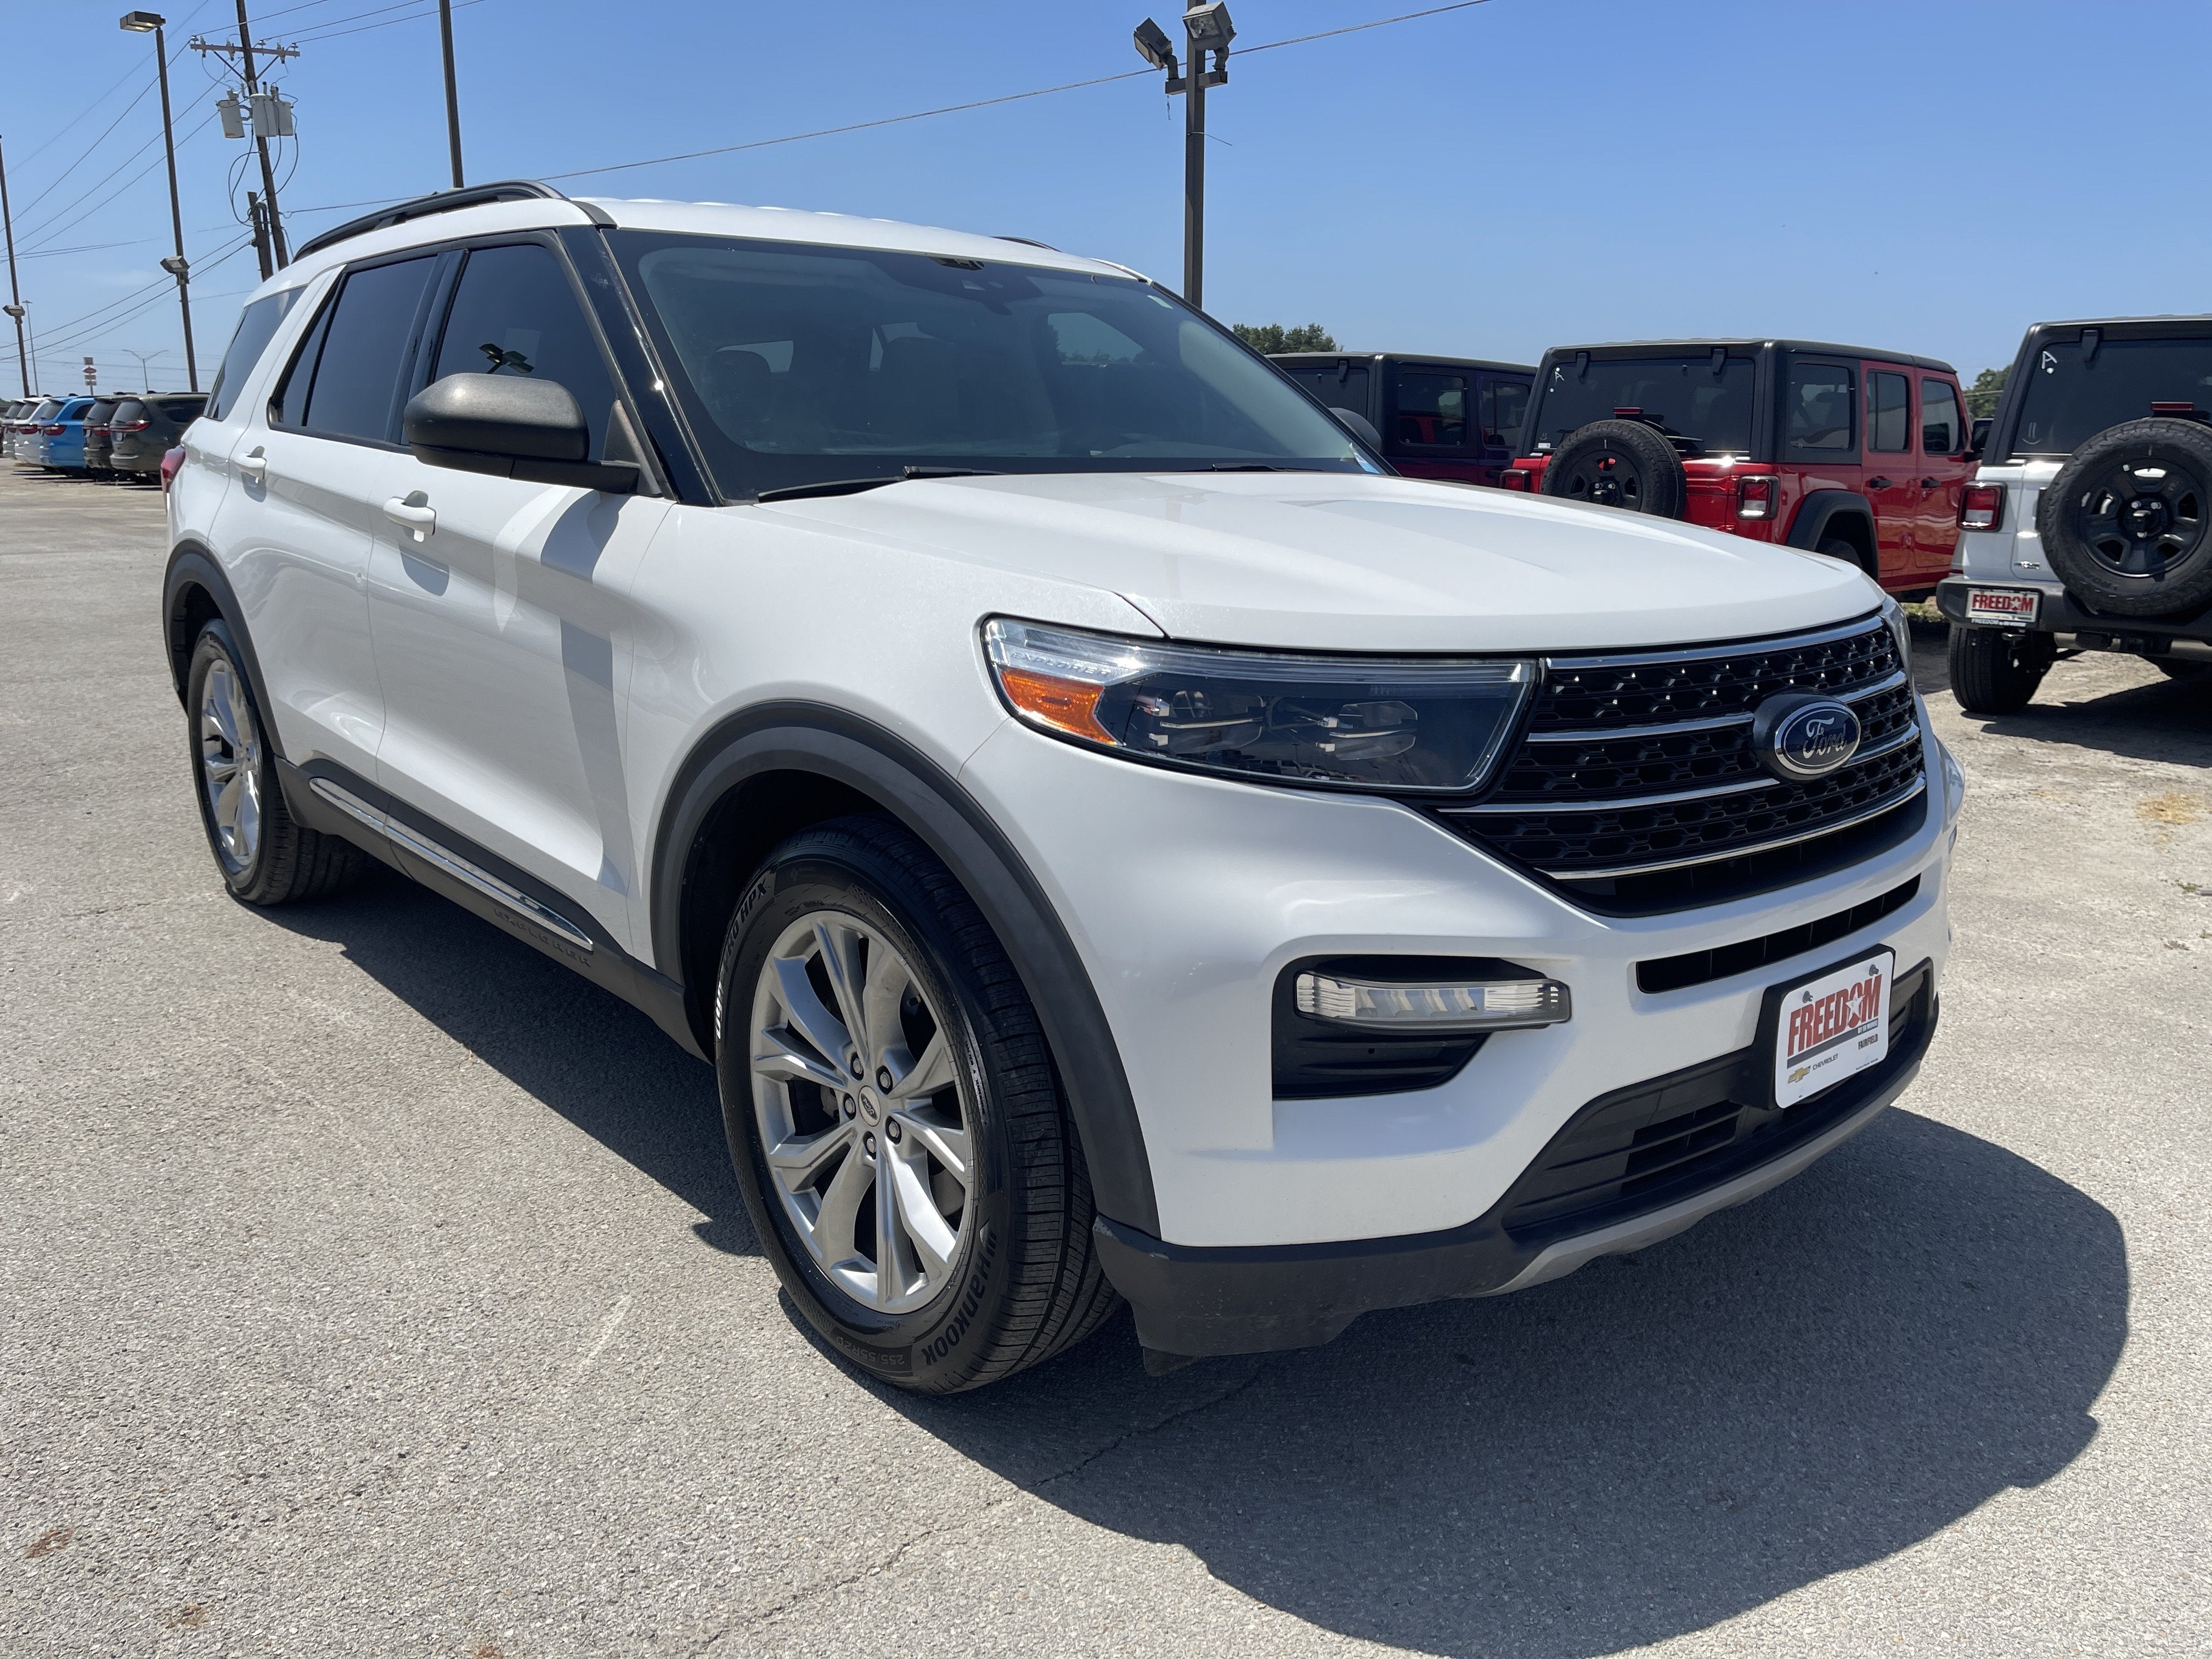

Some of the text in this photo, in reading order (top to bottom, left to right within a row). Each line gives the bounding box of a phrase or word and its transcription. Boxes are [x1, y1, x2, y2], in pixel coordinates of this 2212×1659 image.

[1972, 594, 2034, 612] FREEDOM
[1802, 717, 1847, 759] Ford
[740, 878, 772, 923] HPX
[494, 909, 591, 968] EXPLORER
[1787, 974, 1882, 1057] FREEDOM
[1813, 1053, 1838, 1070] CHEVROLET
